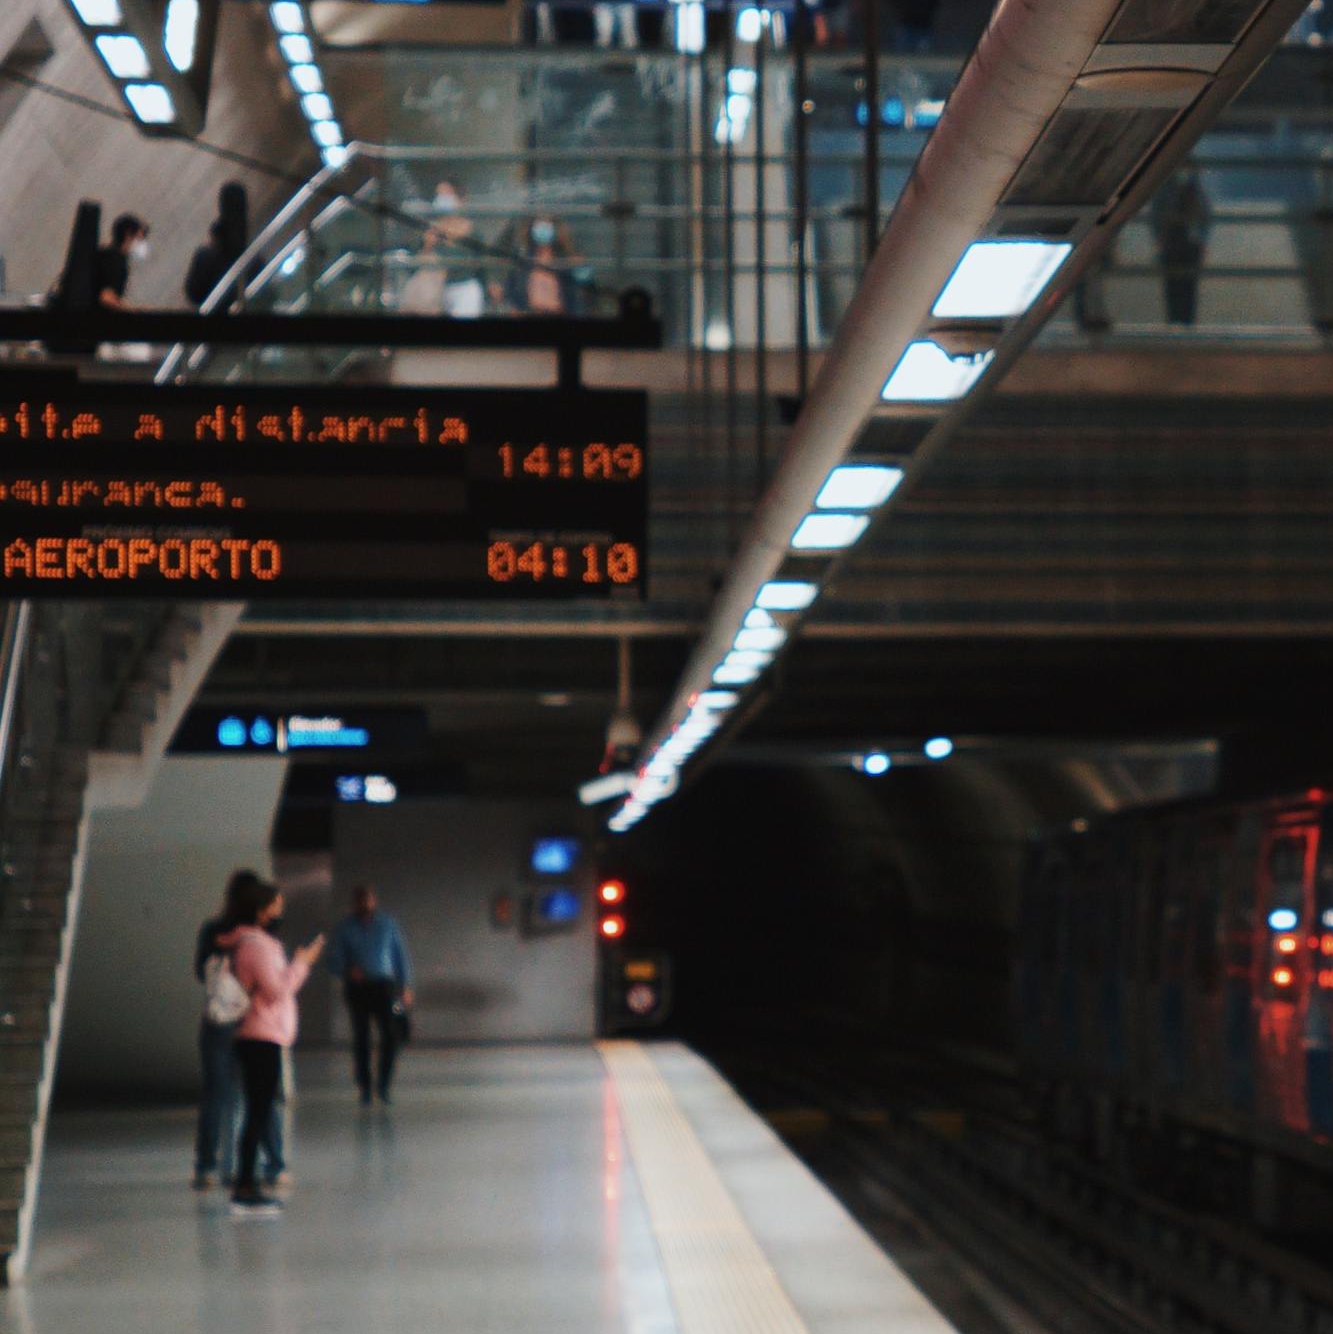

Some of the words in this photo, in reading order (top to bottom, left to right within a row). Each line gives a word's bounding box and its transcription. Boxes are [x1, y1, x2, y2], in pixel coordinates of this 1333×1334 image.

[498, 442, 641, 478] 14:09
[2, 536, 281, 581] AEROPORTO
[487, 540, 638, 583] 04:10
